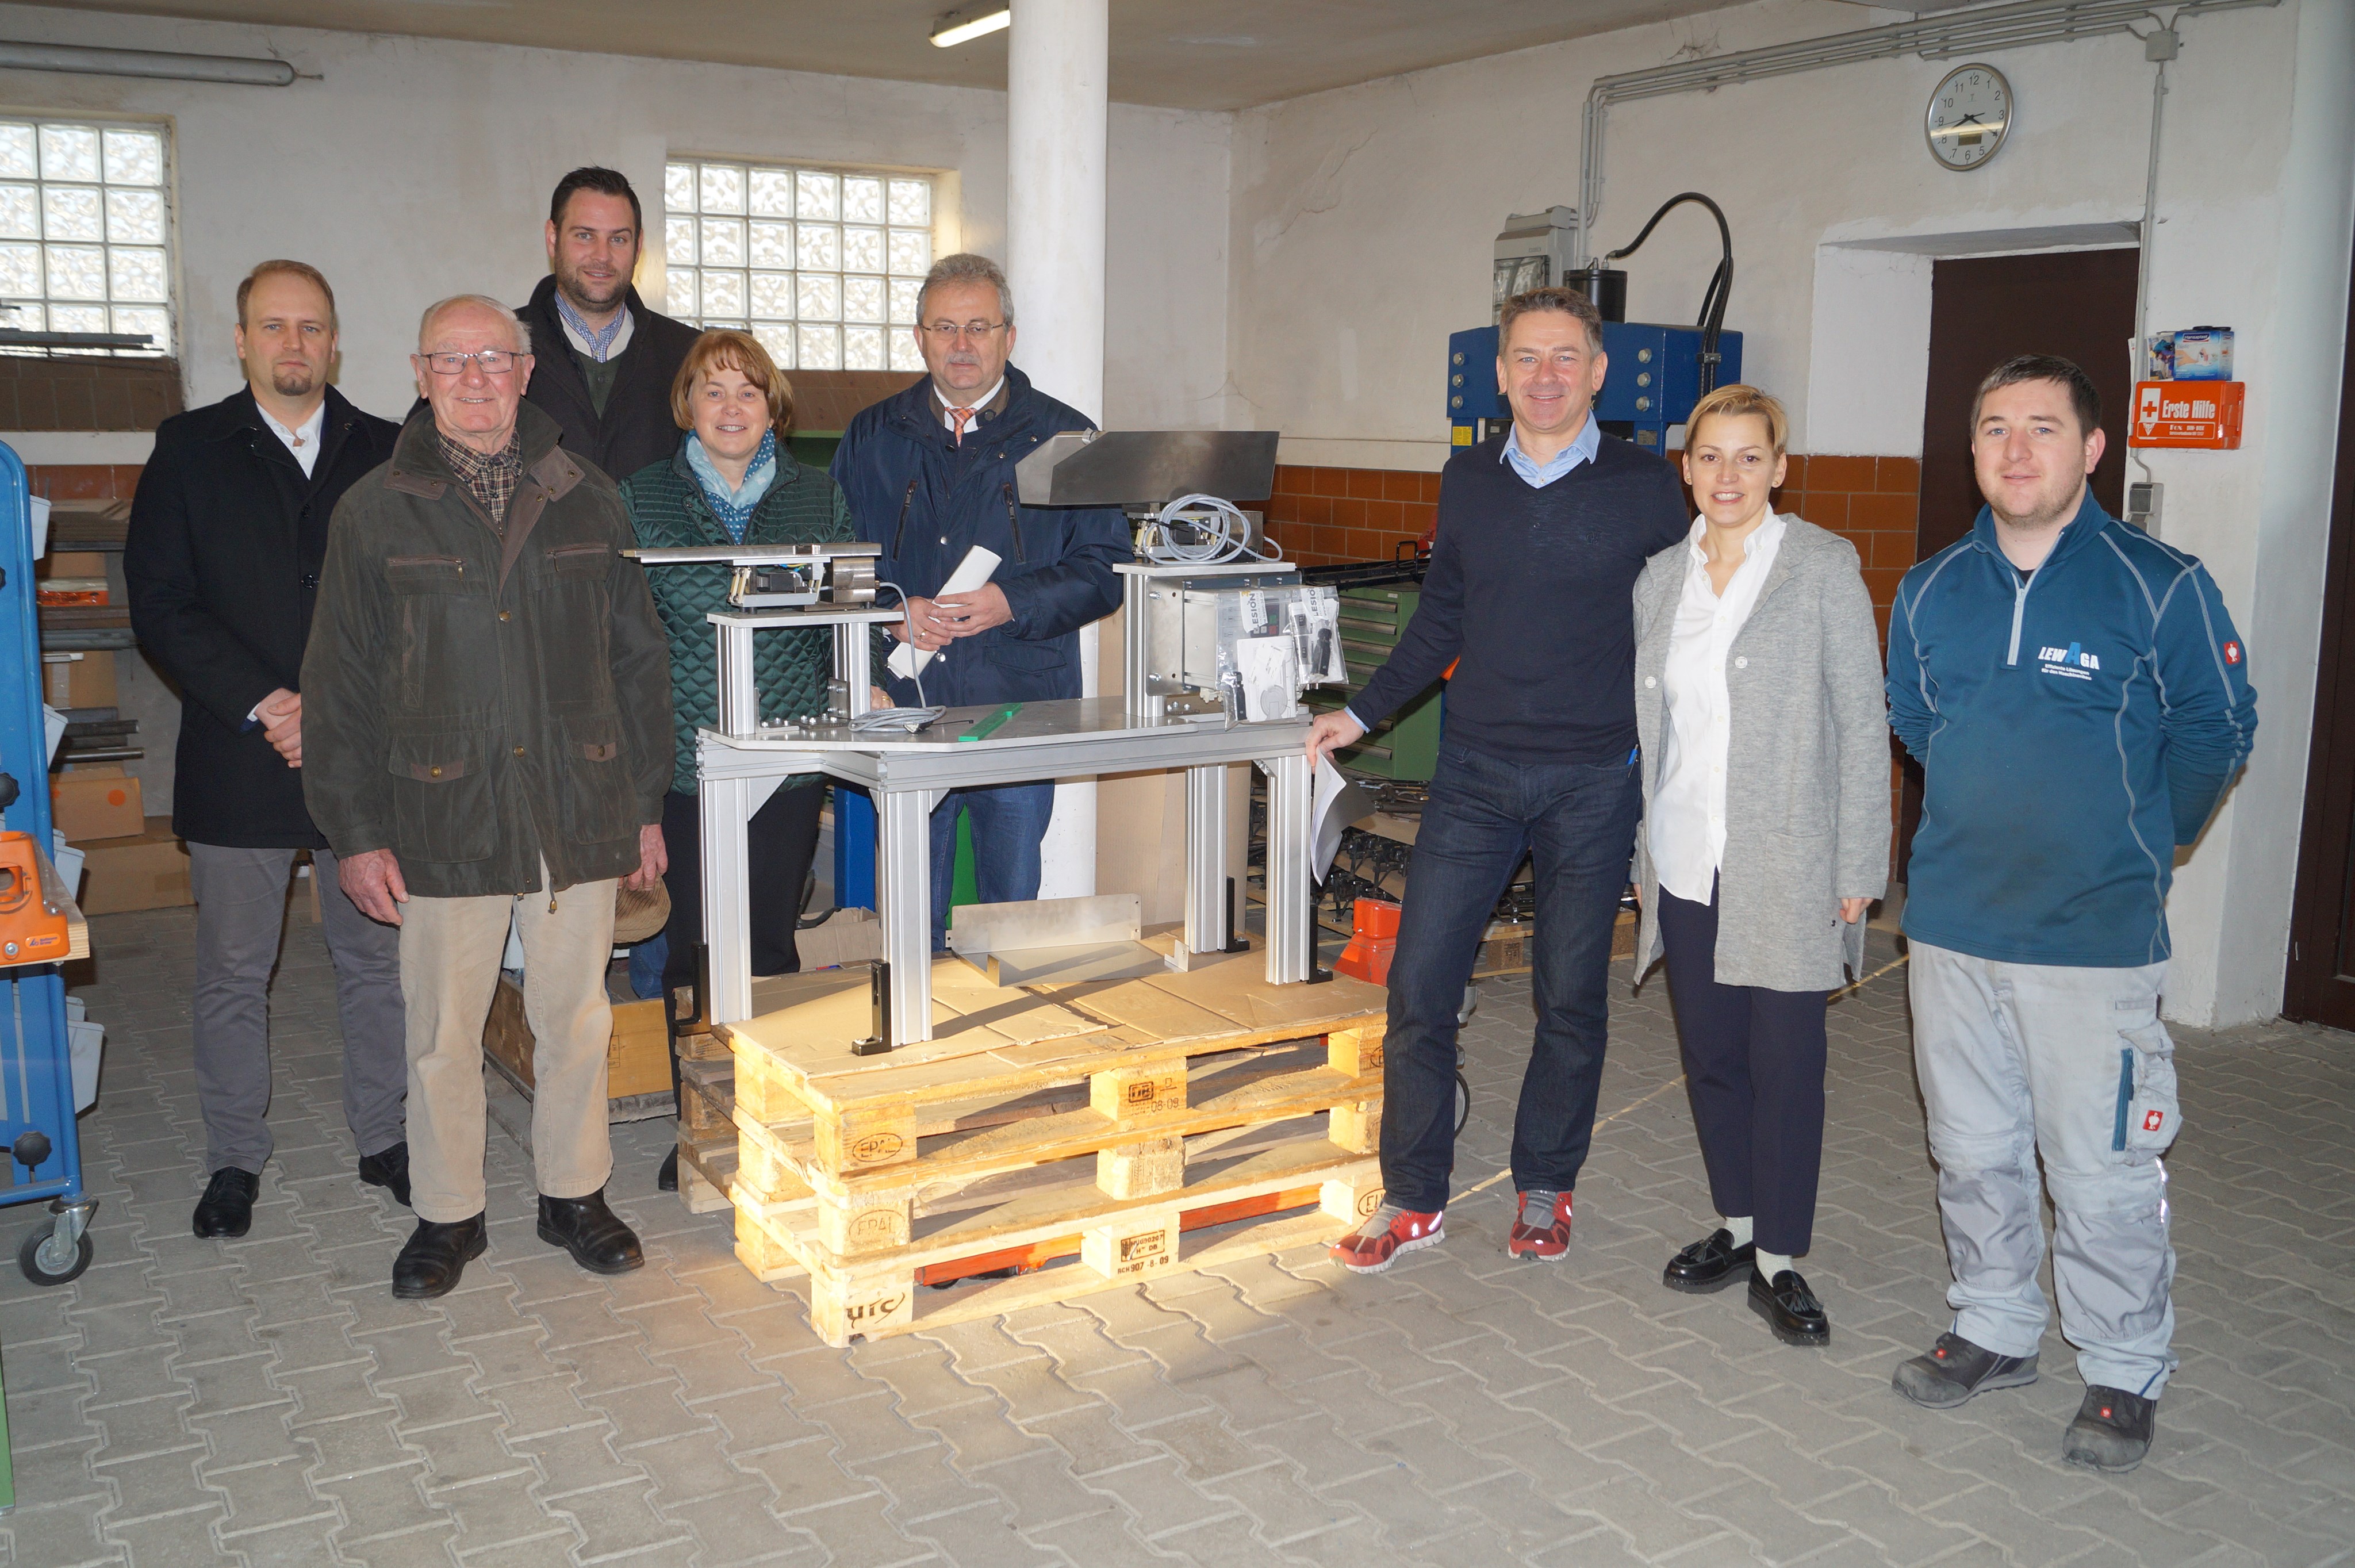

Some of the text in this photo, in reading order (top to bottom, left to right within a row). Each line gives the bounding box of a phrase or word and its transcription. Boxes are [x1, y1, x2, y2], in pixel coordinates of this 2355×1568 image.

[1969, 75, 1980, 85] 12
[1986, 80, 1990, 89] 1
[1955, 83, 1963, 93] 11
[1995, 90, 2000, 101] 2
[1943, 98, 1953, 108] 10
[1999, 110, 2004, 120] 3
[1938, 116, 1944, 126] 9
[1942, 134, 1947, 144] 8
[1951, 149, 1957, 158] 7
[1965, 151, 1970, 160] 6
[1979, 146, 1984, 156] 5
[2162, 400, 2216, 419] Erste Hilfe
[2038, 642, 2100, 670] LEWAGA
